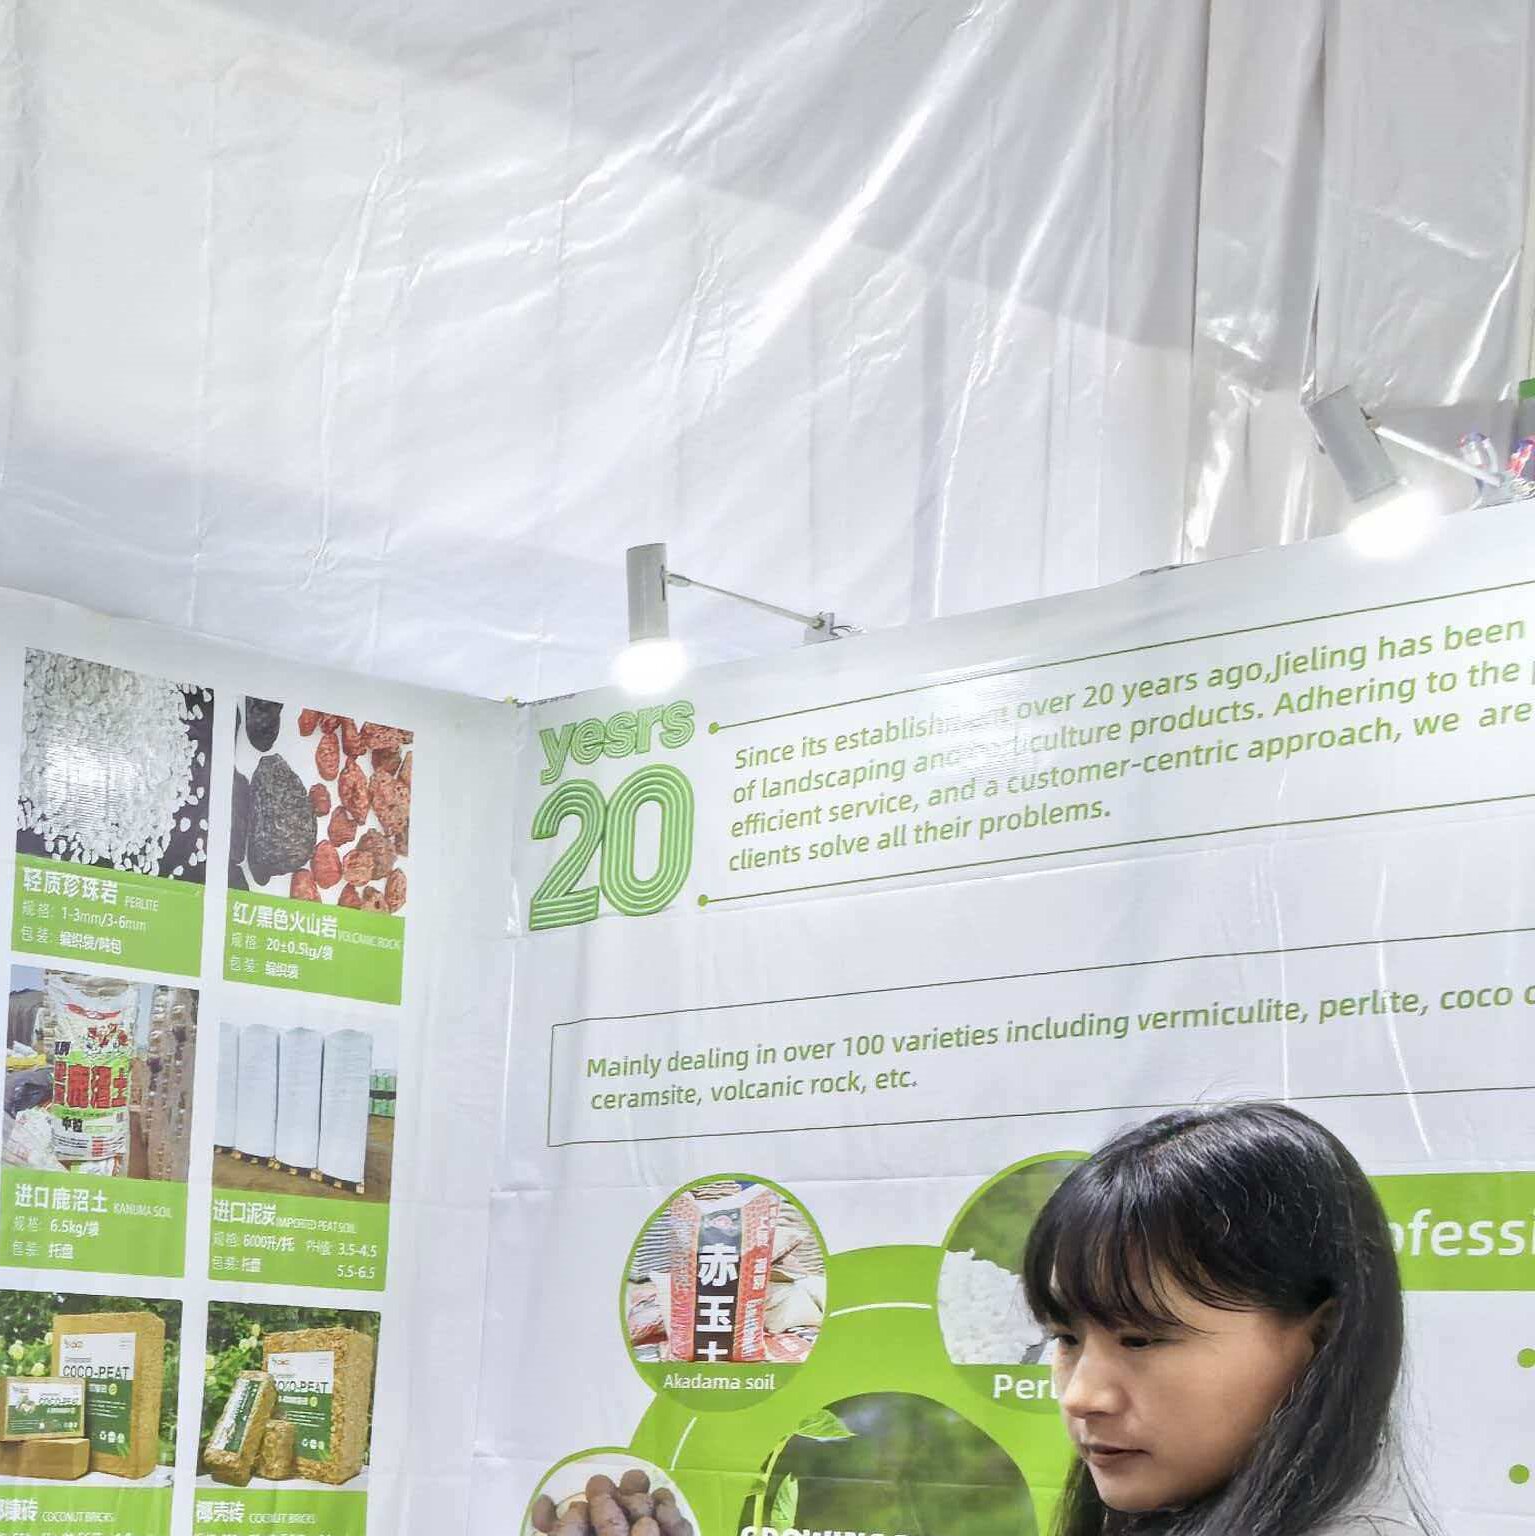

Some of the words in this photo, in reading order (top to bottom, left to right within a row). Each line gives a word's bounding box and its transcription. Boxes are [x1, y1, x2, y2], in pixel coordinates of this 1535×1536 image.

[734, 743, 795, 769] Since
[801, 735, 829, 757] its
[835, 704, 1009, 751] establisht
[1017, 692, 1076, 721] over
[1082, 682, 1115, 708] 20
[1121, 671, 1198, 707] years
[1377, 633, 1432, 660] has
[1444, 617, 1526, 650] been
[733, 779, 756, 803] of
[762, 757, 907, 799] landscaping
[1129, 700, 1264, 744] products.
[1273, 677, 1418, 718] Adhering
[1426, 671, 1457, 694] to
[1467, 660, 1520, 687] the
[730, 803, 823, 839] efficient
[828, 792, 920, 820] service,
[927, 778, 977, 807] and
[983, 779, 999, 797] a
[1007, 743, 1240, 796] customer-centric
[1247, 717, 1402, 760] approach,
[1413, 713, 1459, 738] we
[1478, 701, 1533, 727] are
[529, 763, 695, 930] 20
[729, 843, 801, 872] clients
[808, 833, 870, 861] solve
[877, 828, 908, 850] all
[913, 816, 971, 844] their
[978, 797, 1111, 842] problems.
[23, 866, 118, 905] 轻质珍珠岩
[233, 901, 338, 940] 红/黑色火山岩
[586, 1057, 662, 1080] Mainly
[667, 1049, 749, 1073] dealing
[756, 1043, 777, 1065] in
[783, 1041, 836, 1063] over
[843, 1034, 885, 1057] 100
[892, 1026, 999, 1054] varieties
[1005, 1011, 1128, 1044] including
[1137, 998, 1309, 1033] vermiculite,
[1318, 989, 1428, 1025] perlite,
[1440, 985, 1513, 1010] coco
[590, 1084, 703, 1112] ceramsite,
[710, 1075, 805, 1103] volcanic
[810, 1070, 867, 1097] rock,
[875, 1068, 919, 1091] etc.
[15, 1184, 107, 1214] 进口鹿沼土
[664, 1373, 740, 1391] Akadama
[745, 1373, 776, 1391] soil
[993, 1374, 1059, 1400] Perl
